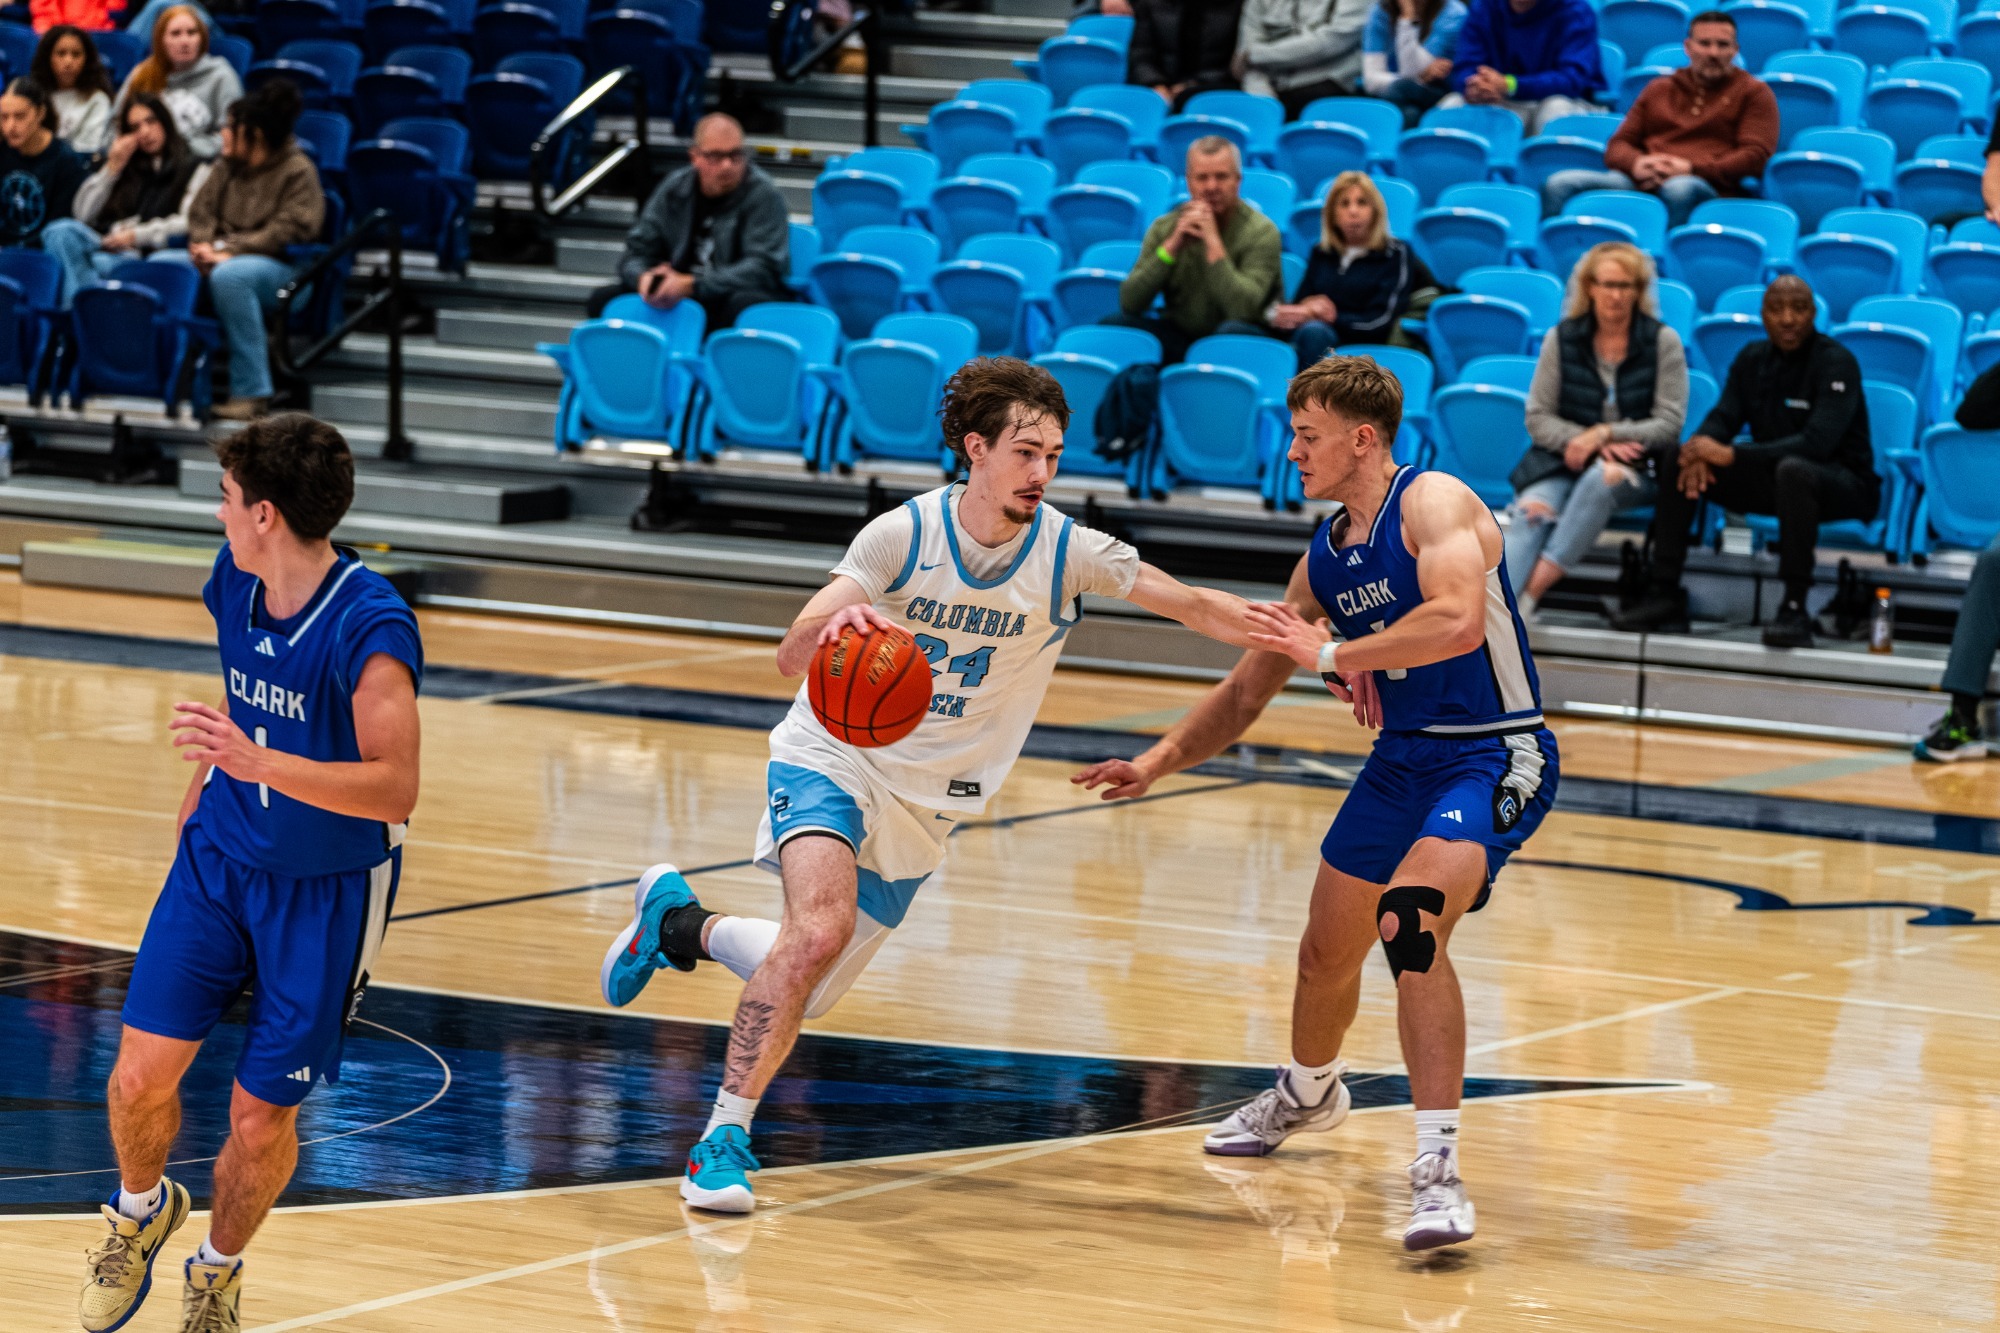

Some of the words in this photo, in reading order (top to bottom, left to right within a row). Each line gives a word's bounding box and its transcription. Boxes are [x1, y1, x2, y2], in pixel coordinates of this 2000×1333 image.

[906, 596, 1028, 638] COLUMBIA
[1336, 577, 1398, 617] CLARK
[914, 632, 997, 687] 24
[230, 666, 306, 722] CLARK
[927, 693, 972, 717] SIN
